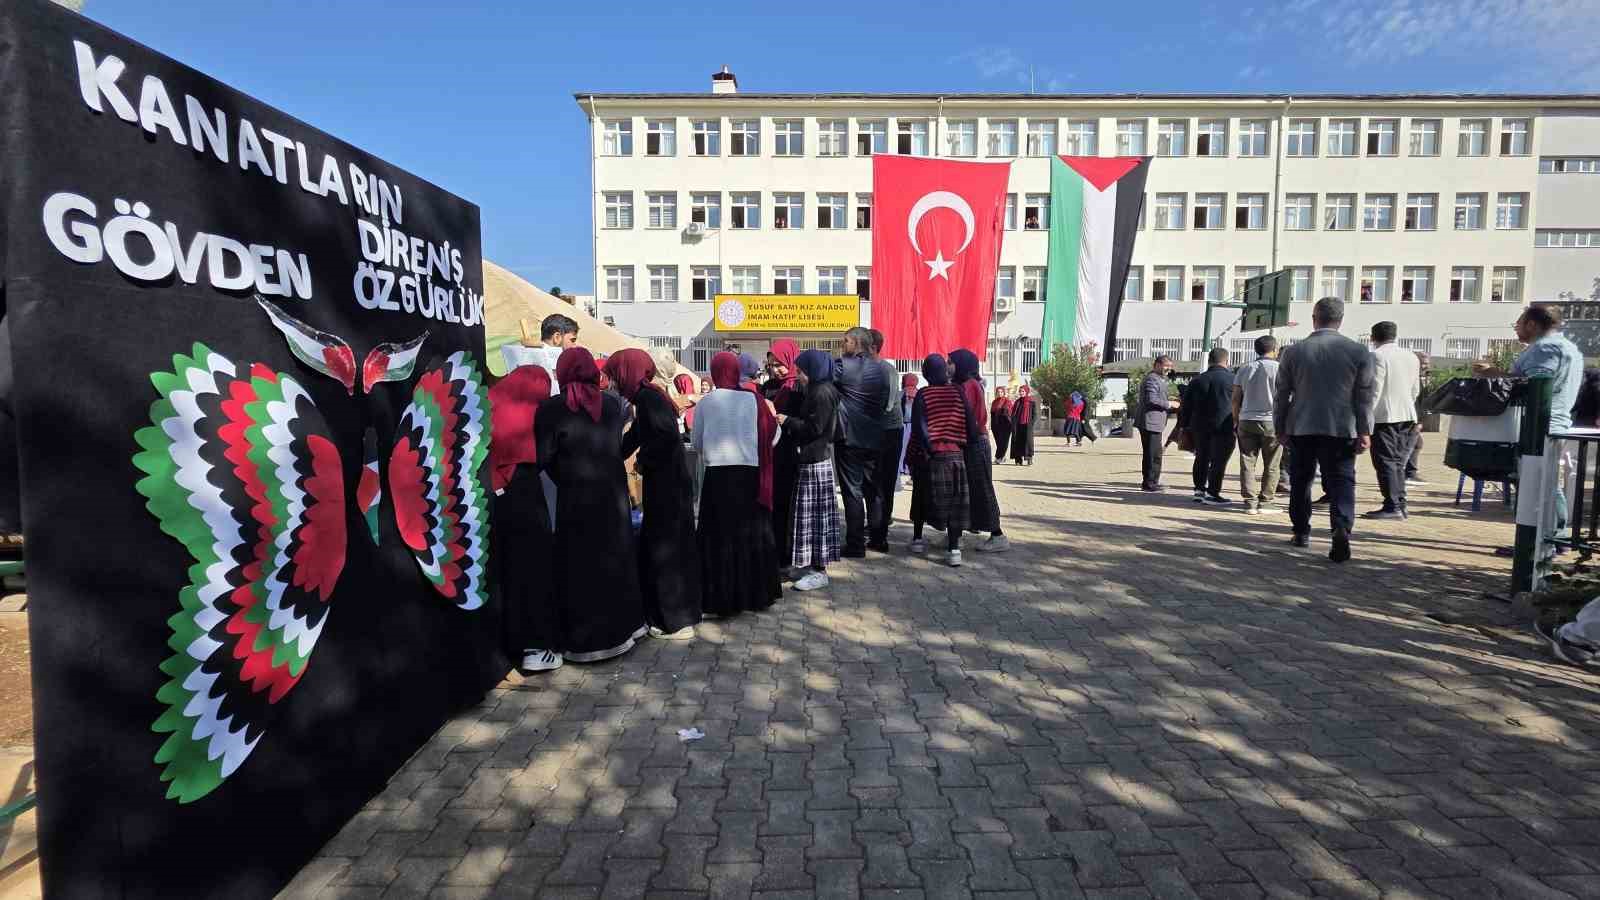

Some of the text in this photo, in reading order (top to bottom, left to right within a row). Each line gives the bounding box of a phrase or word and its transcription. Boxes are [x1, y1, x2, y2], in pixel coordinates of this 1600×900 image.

[73, 40, 402, 224] KANATLARIN
[43, 192, 313, 300] GÖVDEN
[816, 303, 856, 311] ANADOLU
